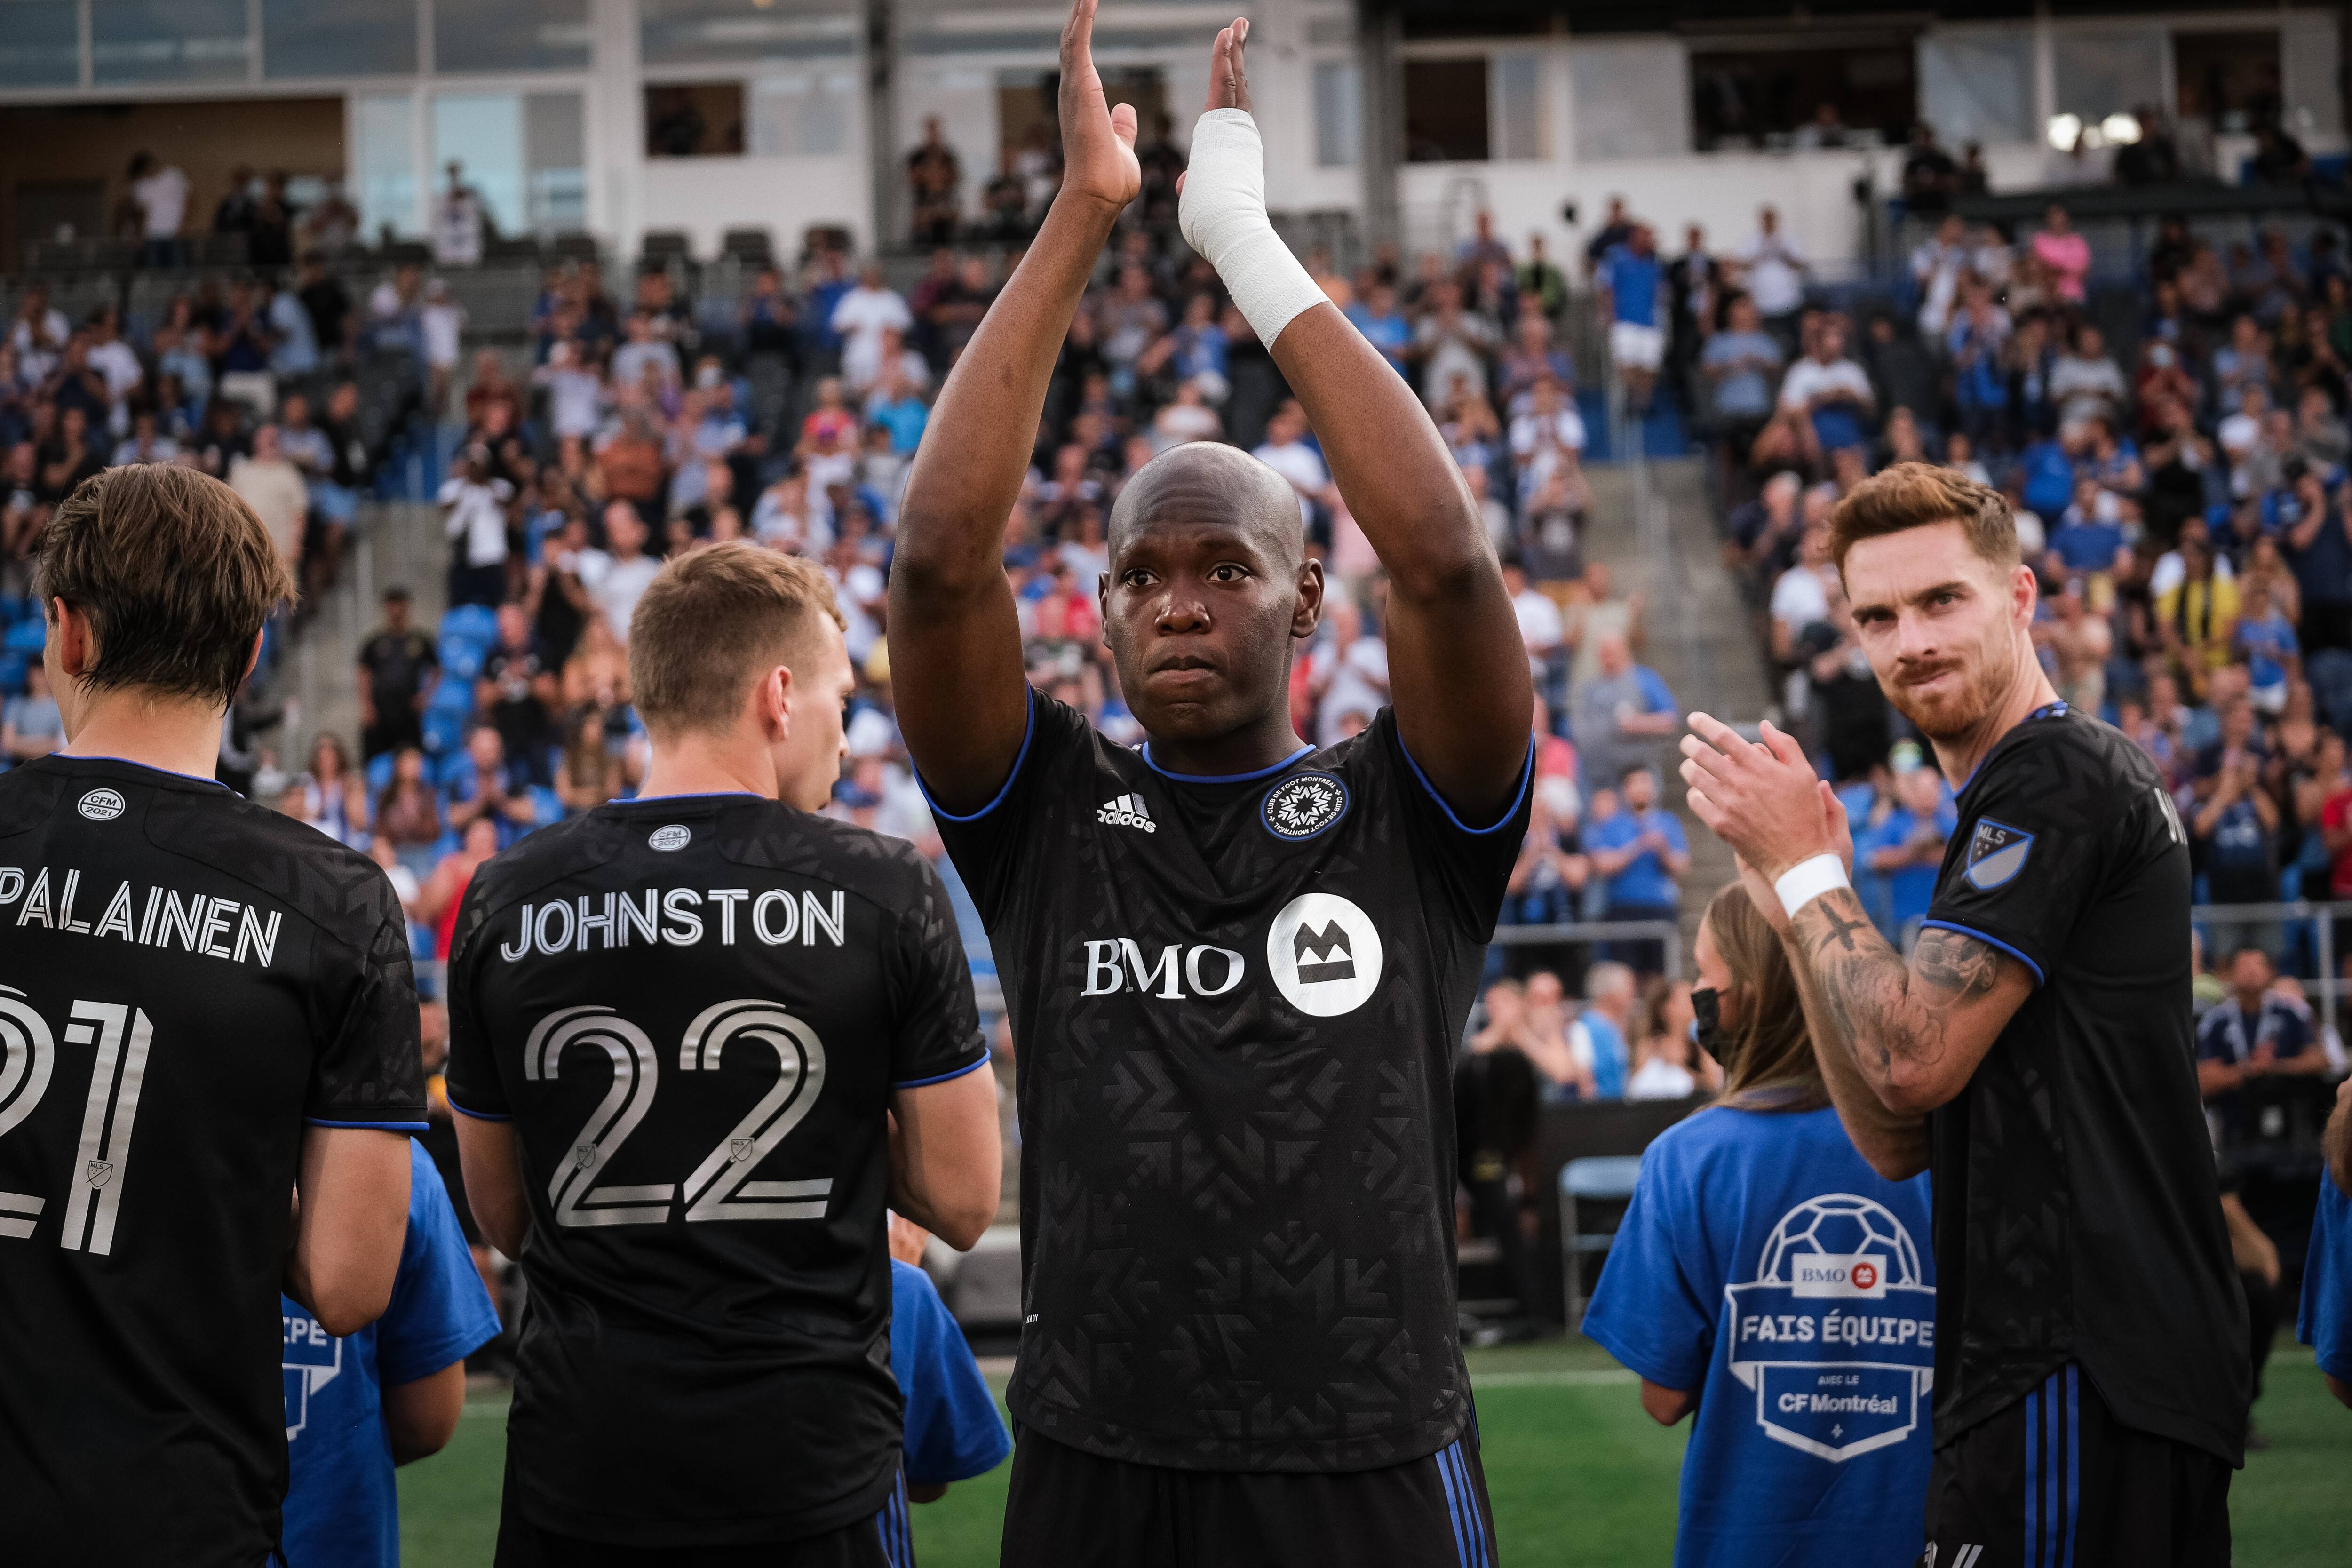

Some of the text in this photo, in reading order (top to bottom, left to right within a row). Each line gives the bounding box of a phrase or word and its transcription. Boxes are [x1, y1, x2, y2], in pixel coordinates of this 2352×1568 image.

[90, 796, 117, 806] CFM
[1267, 776, 1336, 814] CLUB DE FOOT MONTRÉAL
[85, 806, 112, 816] 2021
[1097, 809, 1156, 833] adidas
[1327, 811, 1337, 820] DE
[1311, 819, 1329, 832] FOOT
[1977, 824, 2007, 844] MLS
[0, 866, 282, 967] PALAINEN
[501, 888, 845, 963] JOHNSTON
[1080, 937, 1245, 1000] BMO
[524, 999, 834, 1227] 22
[1802, 1268, 1846, 1281] BMO
[1741, 1309, 1934, 1347] FAIS ÉQUIPE
[1818, 1375, 1859, 1385] AVEC LE
[1778, 1393, 1898, 1415] CF Montréal
